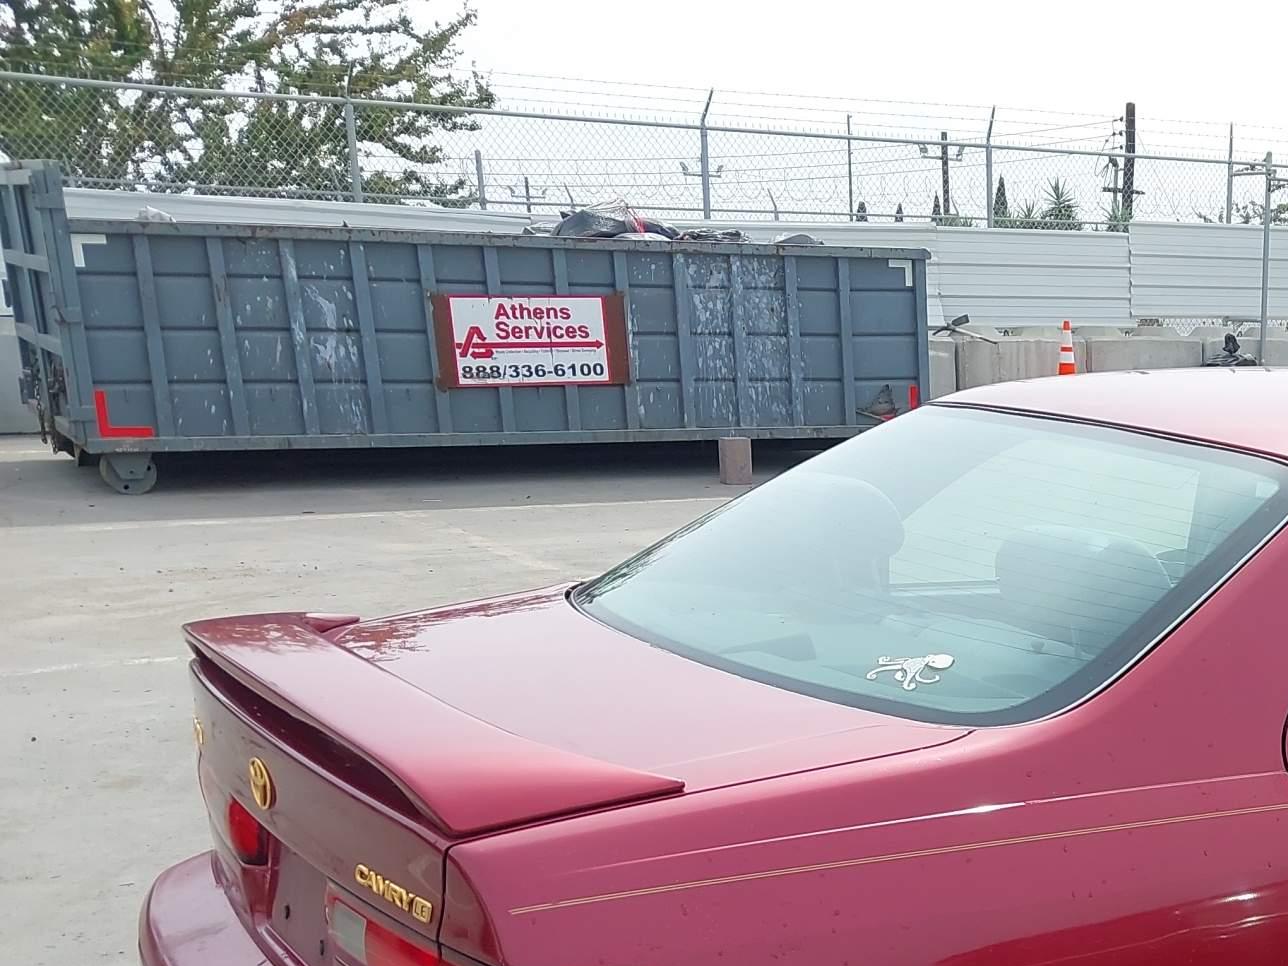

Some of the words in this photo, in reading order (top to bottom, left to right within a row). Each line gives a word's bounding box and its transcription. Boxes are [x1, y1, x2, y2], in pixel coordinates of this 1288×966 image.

[495, 303, 571, 320] Athens
[495, 321, 590, 340] Services
[461, 363, 605, 380] 888/336-6100
[354, 863, 416, 912] CAMRY
[413, 898, 430, 921] LE
